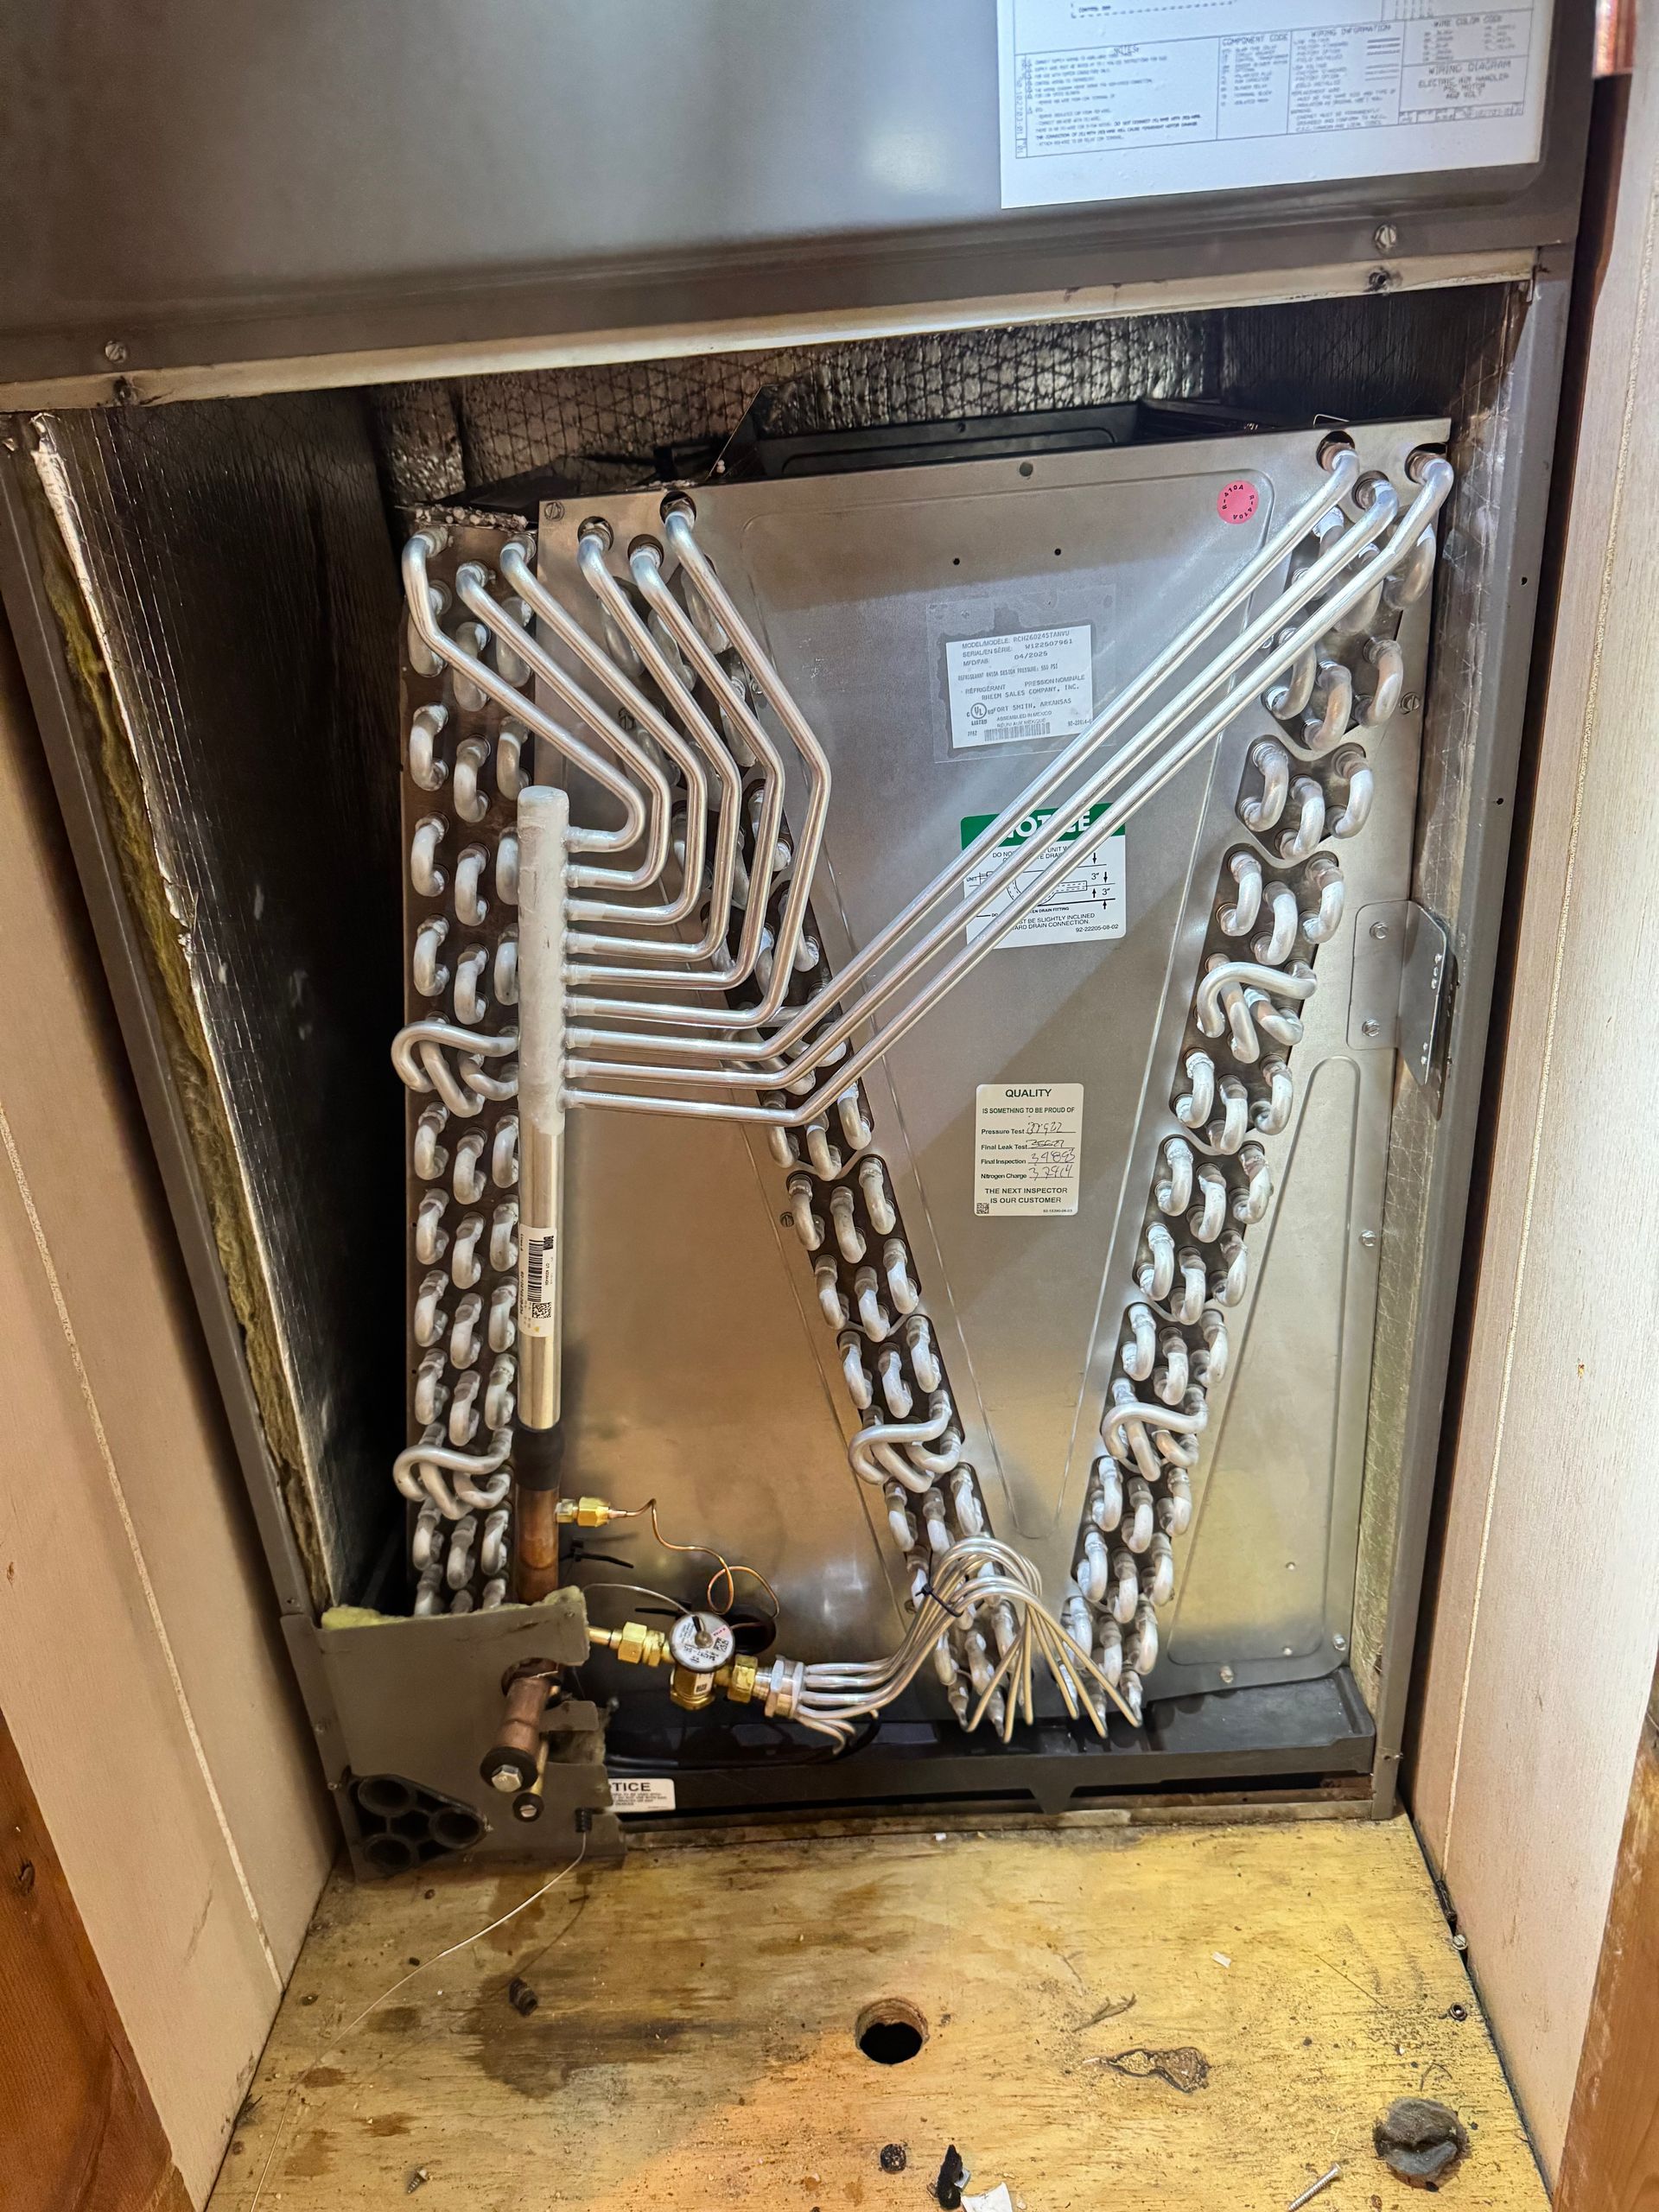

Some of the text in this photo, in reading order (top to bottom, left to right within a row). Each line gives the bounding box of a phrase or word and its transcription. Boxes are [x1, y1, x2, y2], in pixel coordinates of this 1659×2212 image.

[1039, 698, 1071, 708] ARKANSAS
[1005, 1088, 1052, 1098] QUALITY
[612, 1782, 652, 1792] TICE
